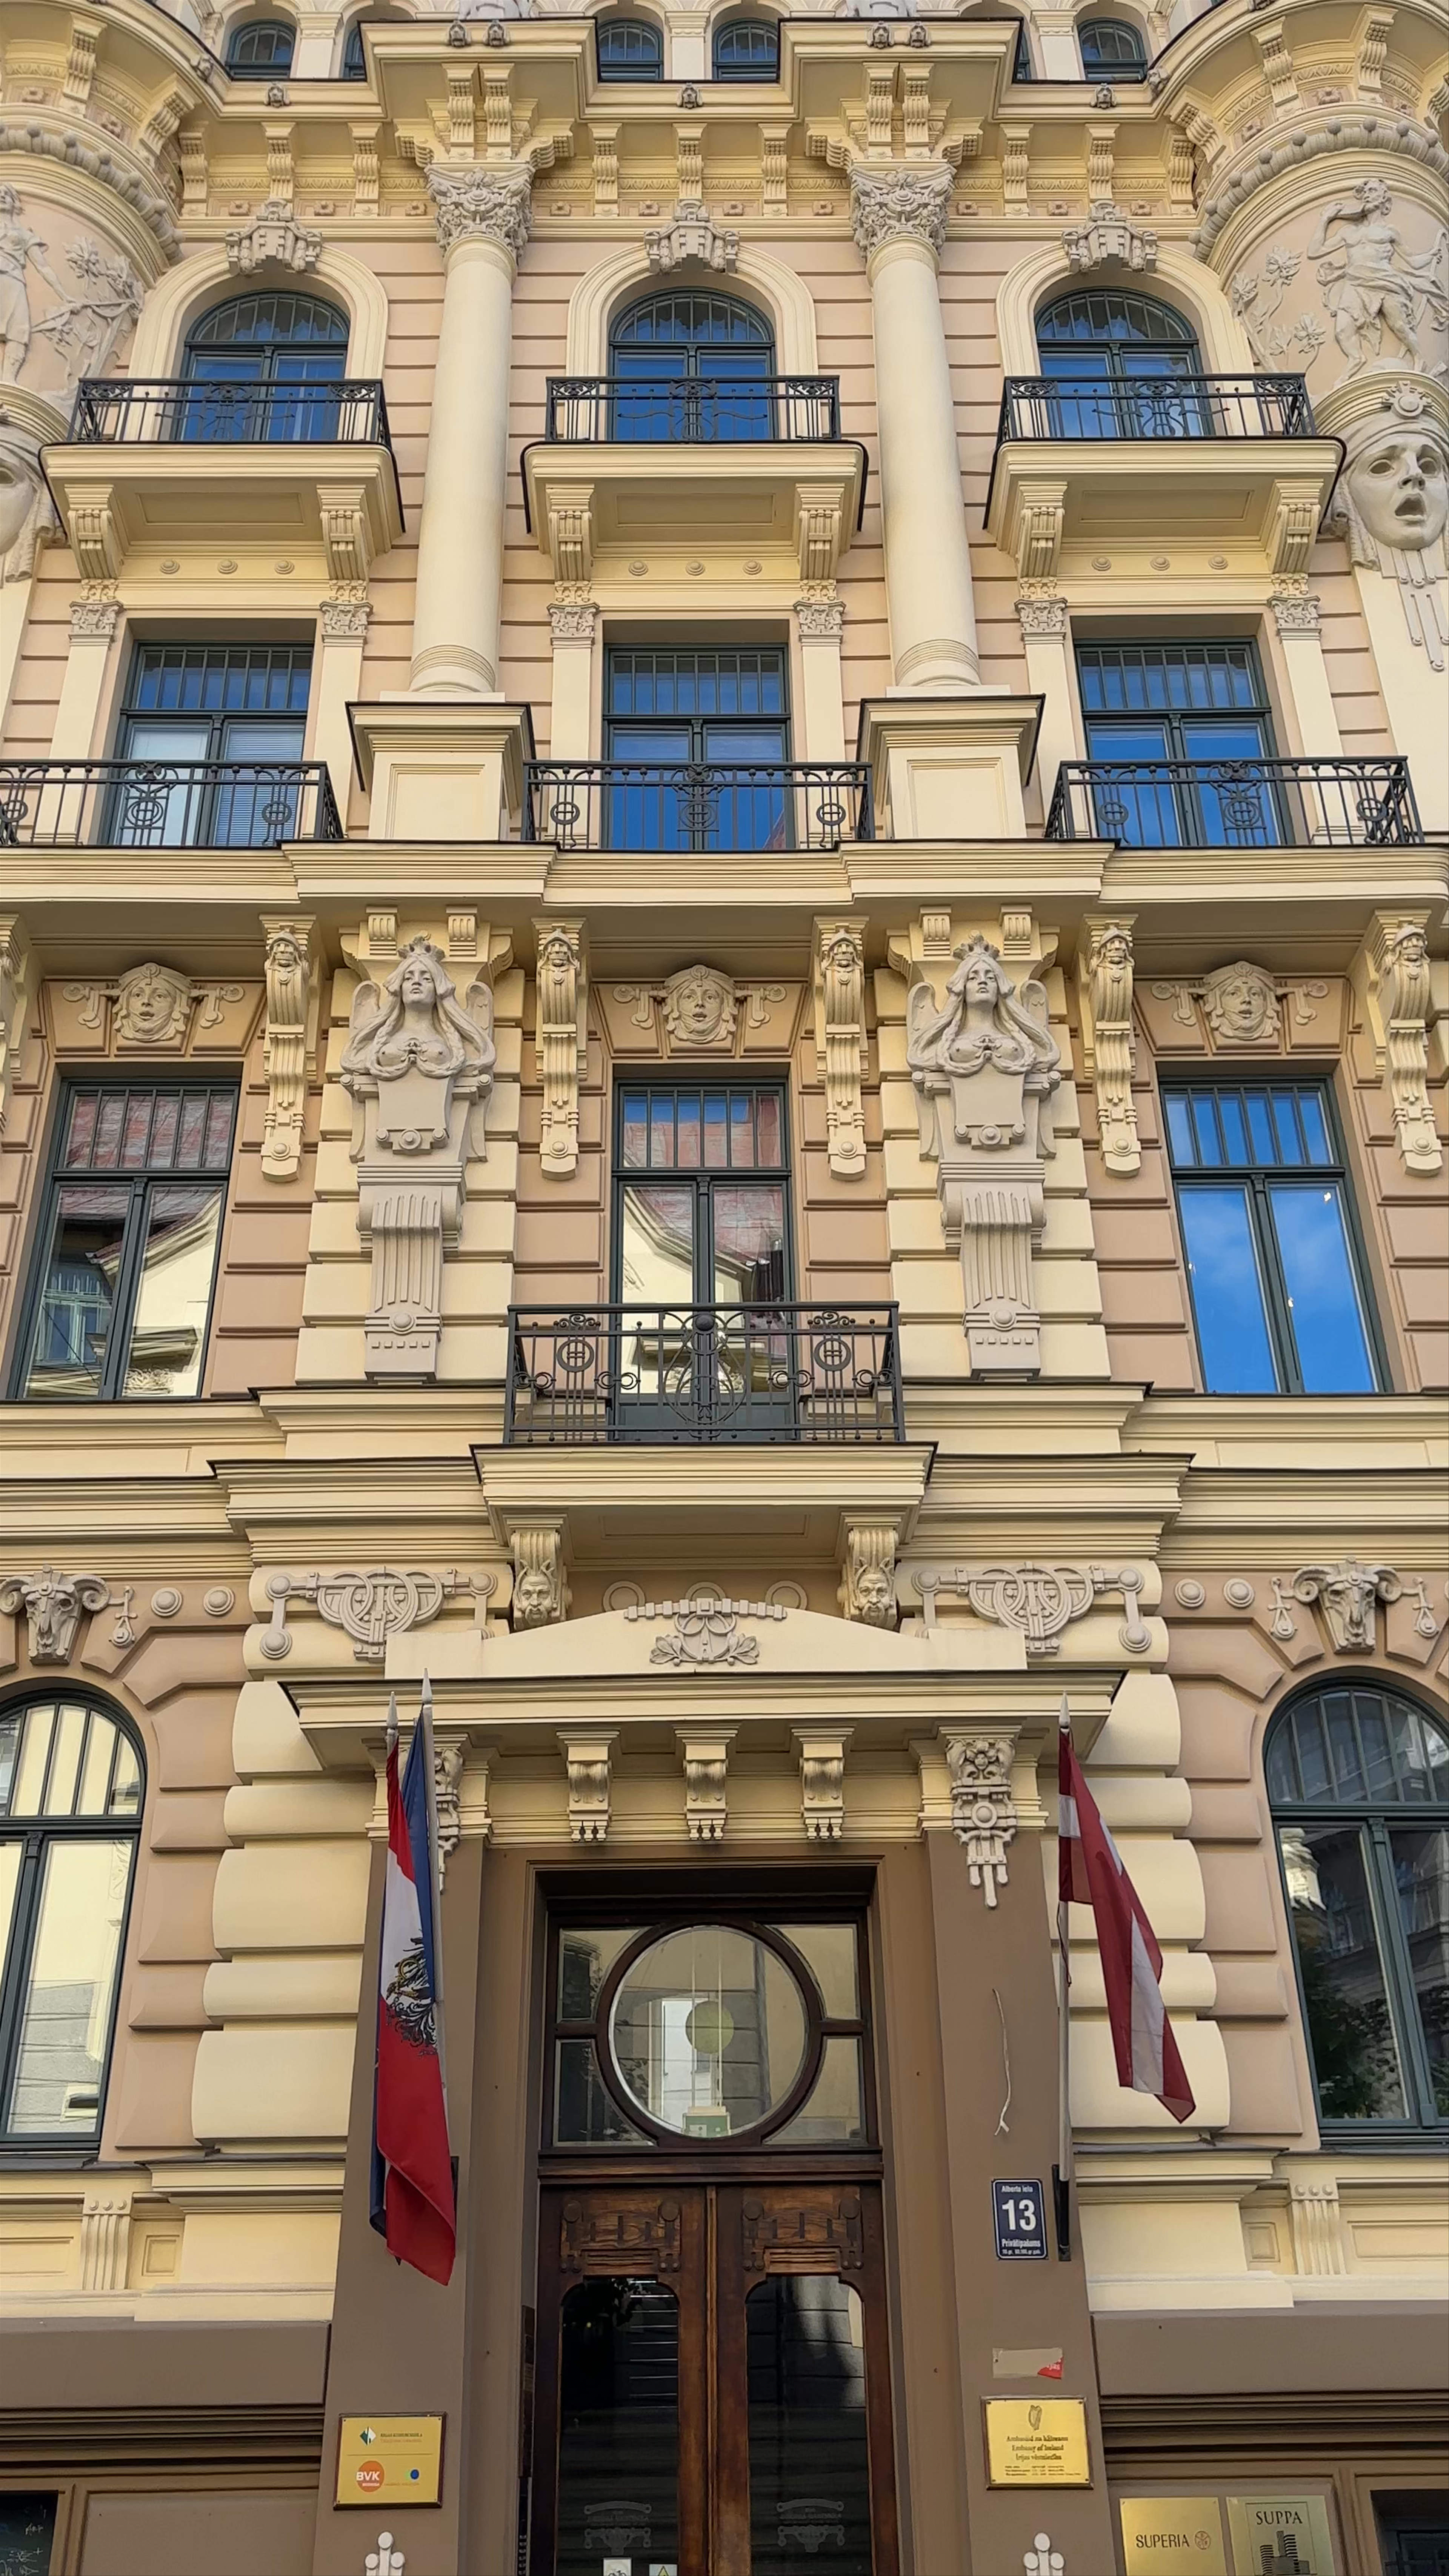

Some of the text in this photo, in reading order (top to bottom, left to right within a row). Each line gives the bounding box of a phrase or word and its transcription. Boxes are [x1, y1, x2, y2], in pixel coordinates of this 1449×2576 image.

[1002, 2199, 1037, 2231] 13
[356, 2471, 380, 2481] BVK
[1256, 2511, 1303, 2525] SUPPA
[1135, 2534, 1190, 2548] SUPERIA
